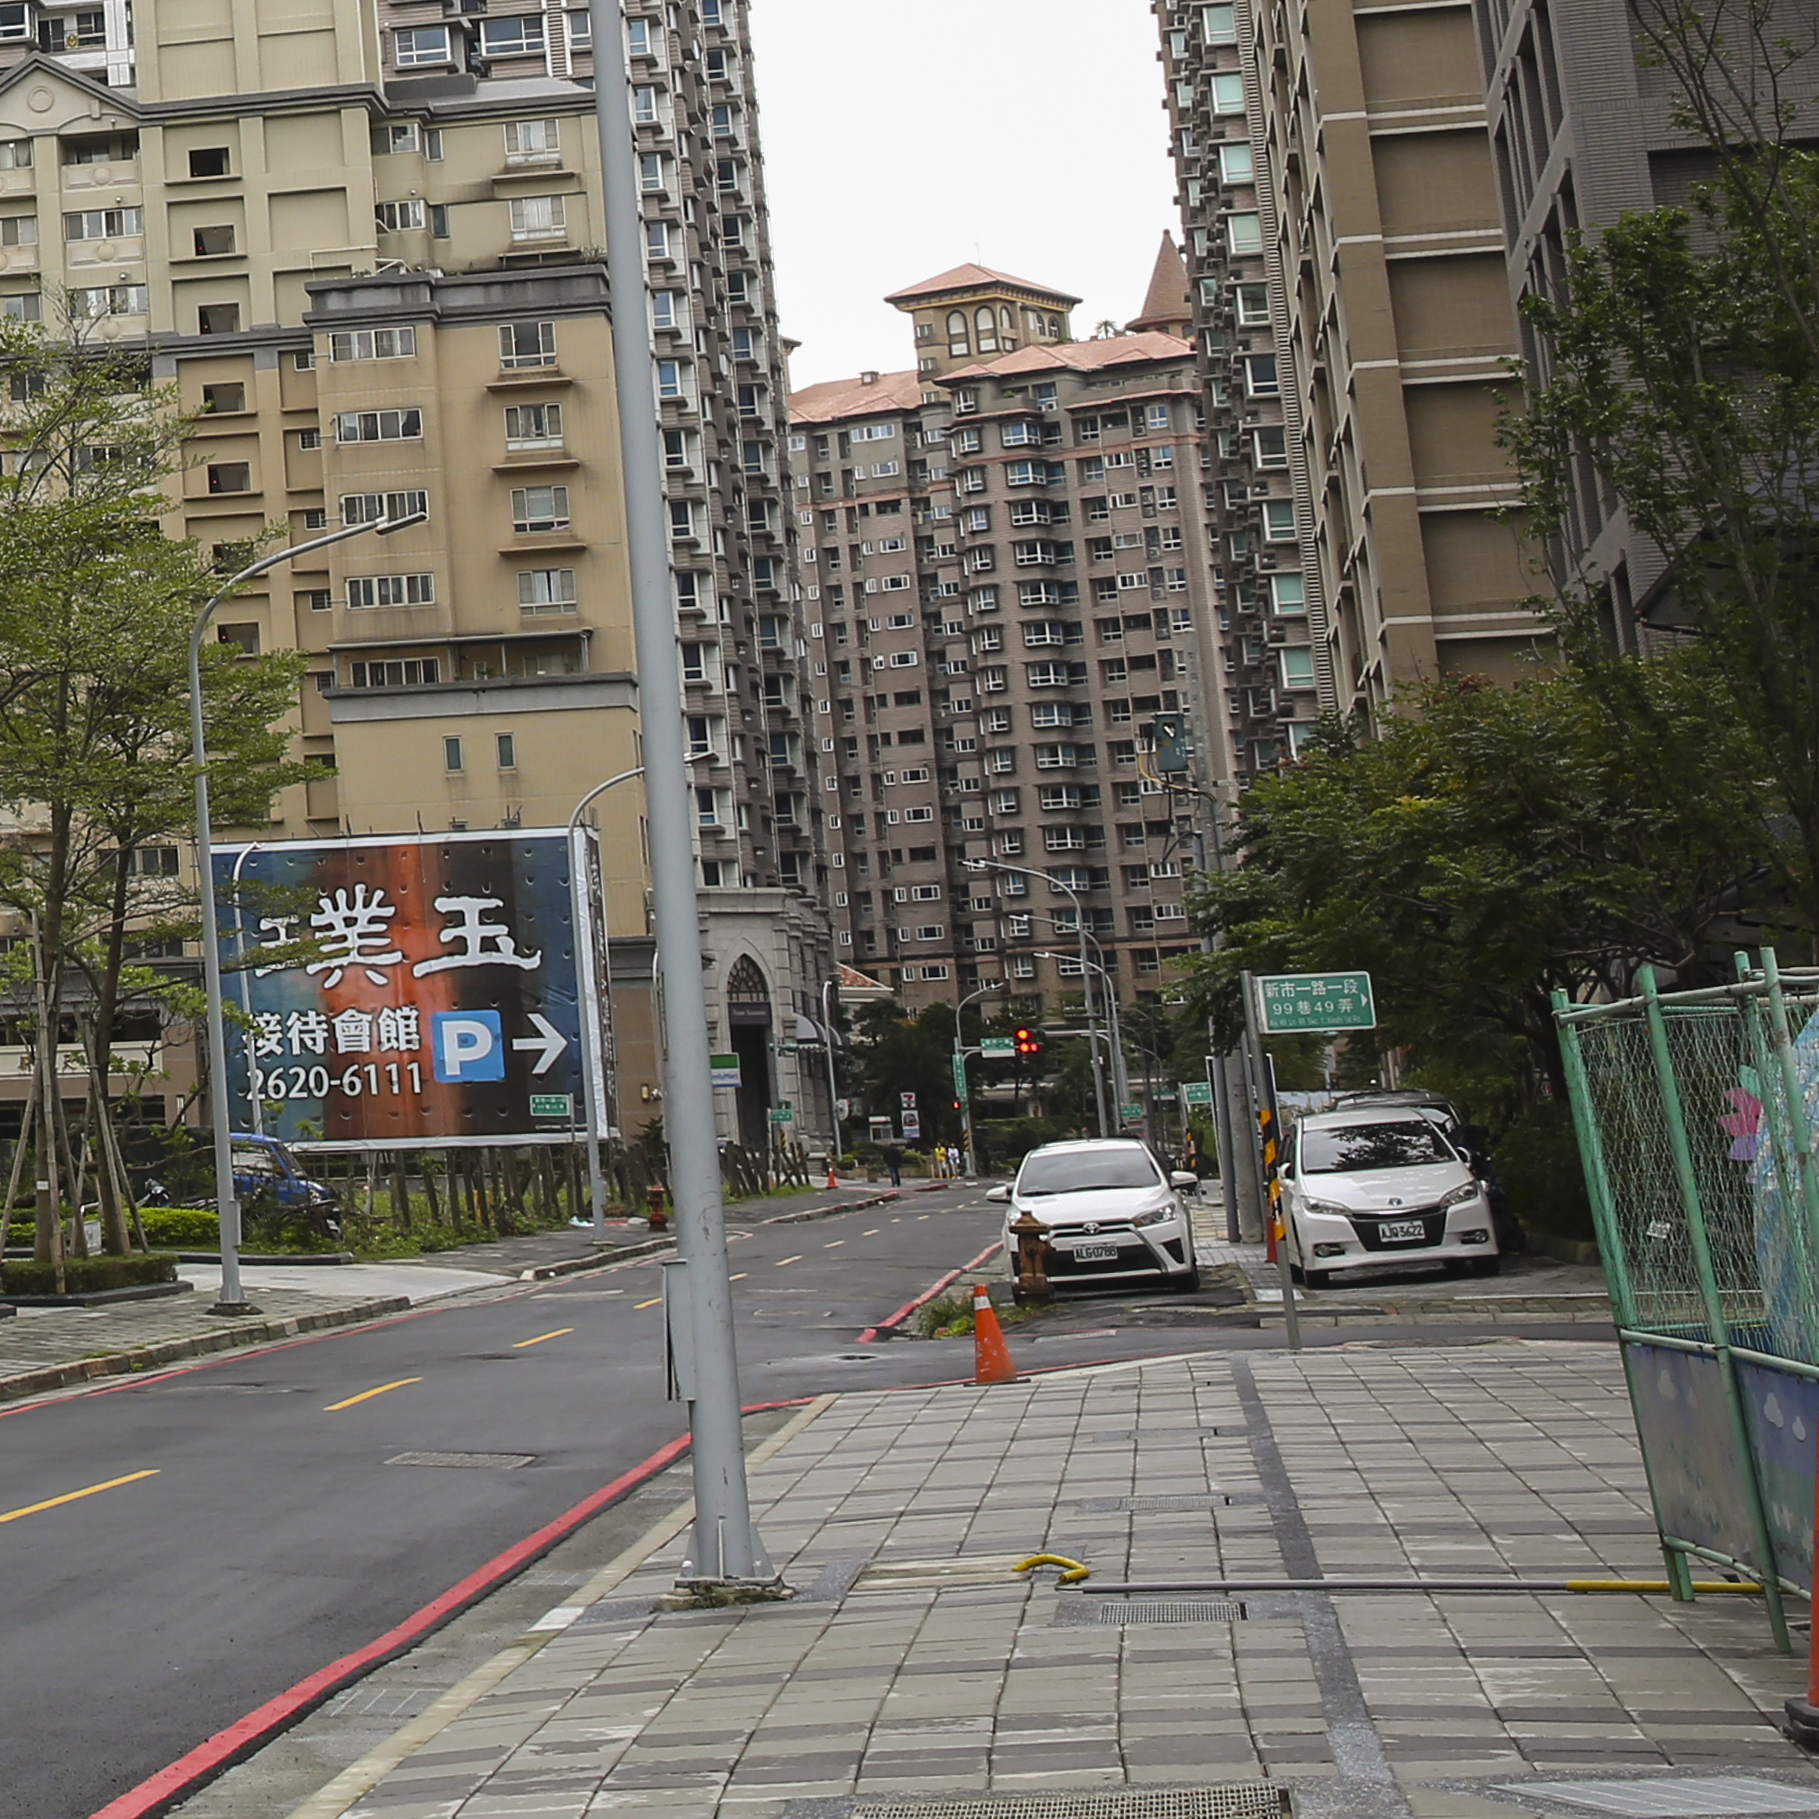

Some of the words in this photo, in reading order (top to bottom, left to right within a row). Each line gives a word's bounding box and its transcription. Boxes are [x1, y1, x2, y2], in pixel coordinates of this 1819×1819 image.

[1265, 979, 1359, 999] 新市一路一段
[246, 1062, 422, 1101] 2620-6111
